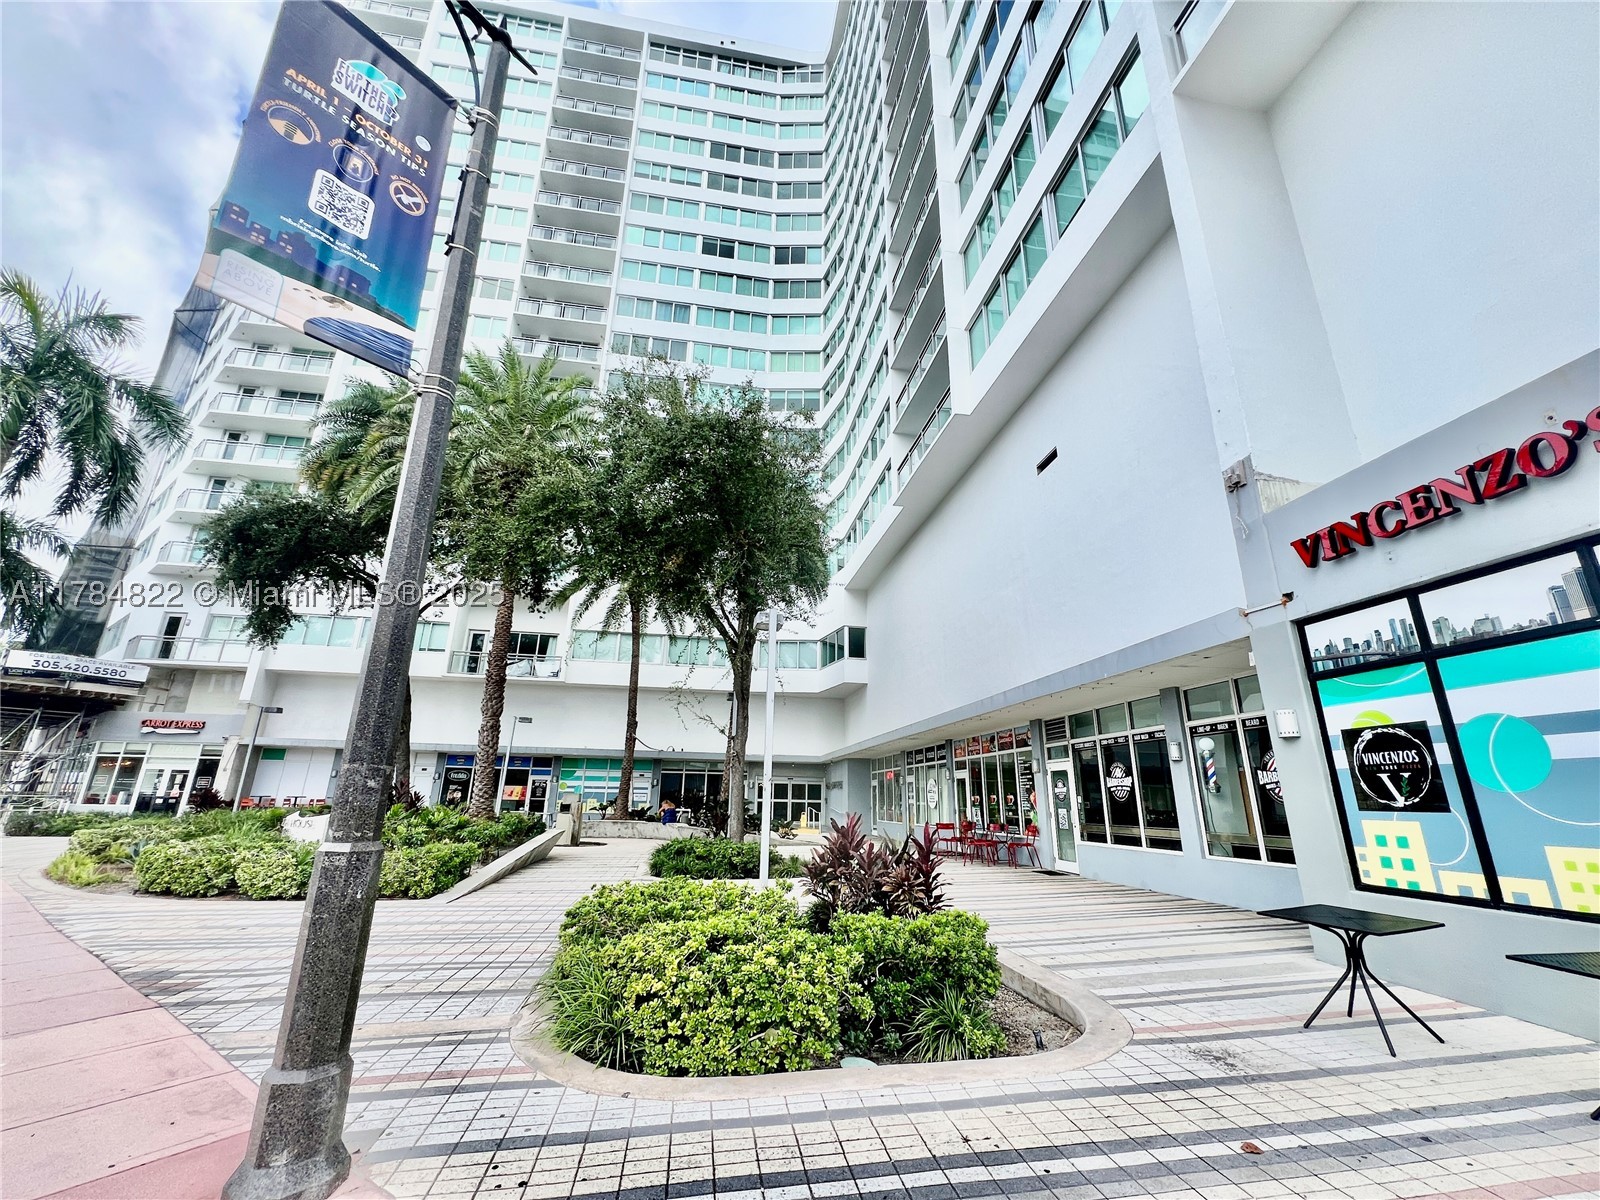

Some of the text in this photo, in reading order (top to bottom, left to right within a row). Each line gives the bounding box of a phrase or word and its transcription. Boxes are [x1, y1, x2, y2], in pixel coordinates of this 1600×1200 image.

[335, 71, 385, 115] SWITCH
[338, 60, 387, 102] FLIP THE
[283, 76, 337, 116] TURTLE
[341, 114, 396, 156] SEASON
[401, 154, 426, 177] TIPS
[285, 68, 328, 99] APRIL
[333, 96, 339, 106] 1
[355, 114, 412, 157] OCTOBER
[415, 154, 428, 168] 31
[222, 268, 272, 297] ABOVE
[227, 259, 274, 288] RISING
[31, 659, 127, 678] 305.420.5580
[171, 719, 206, 729] EXPRESS
[1361, 749, 1419, 766] VINCENZOS
